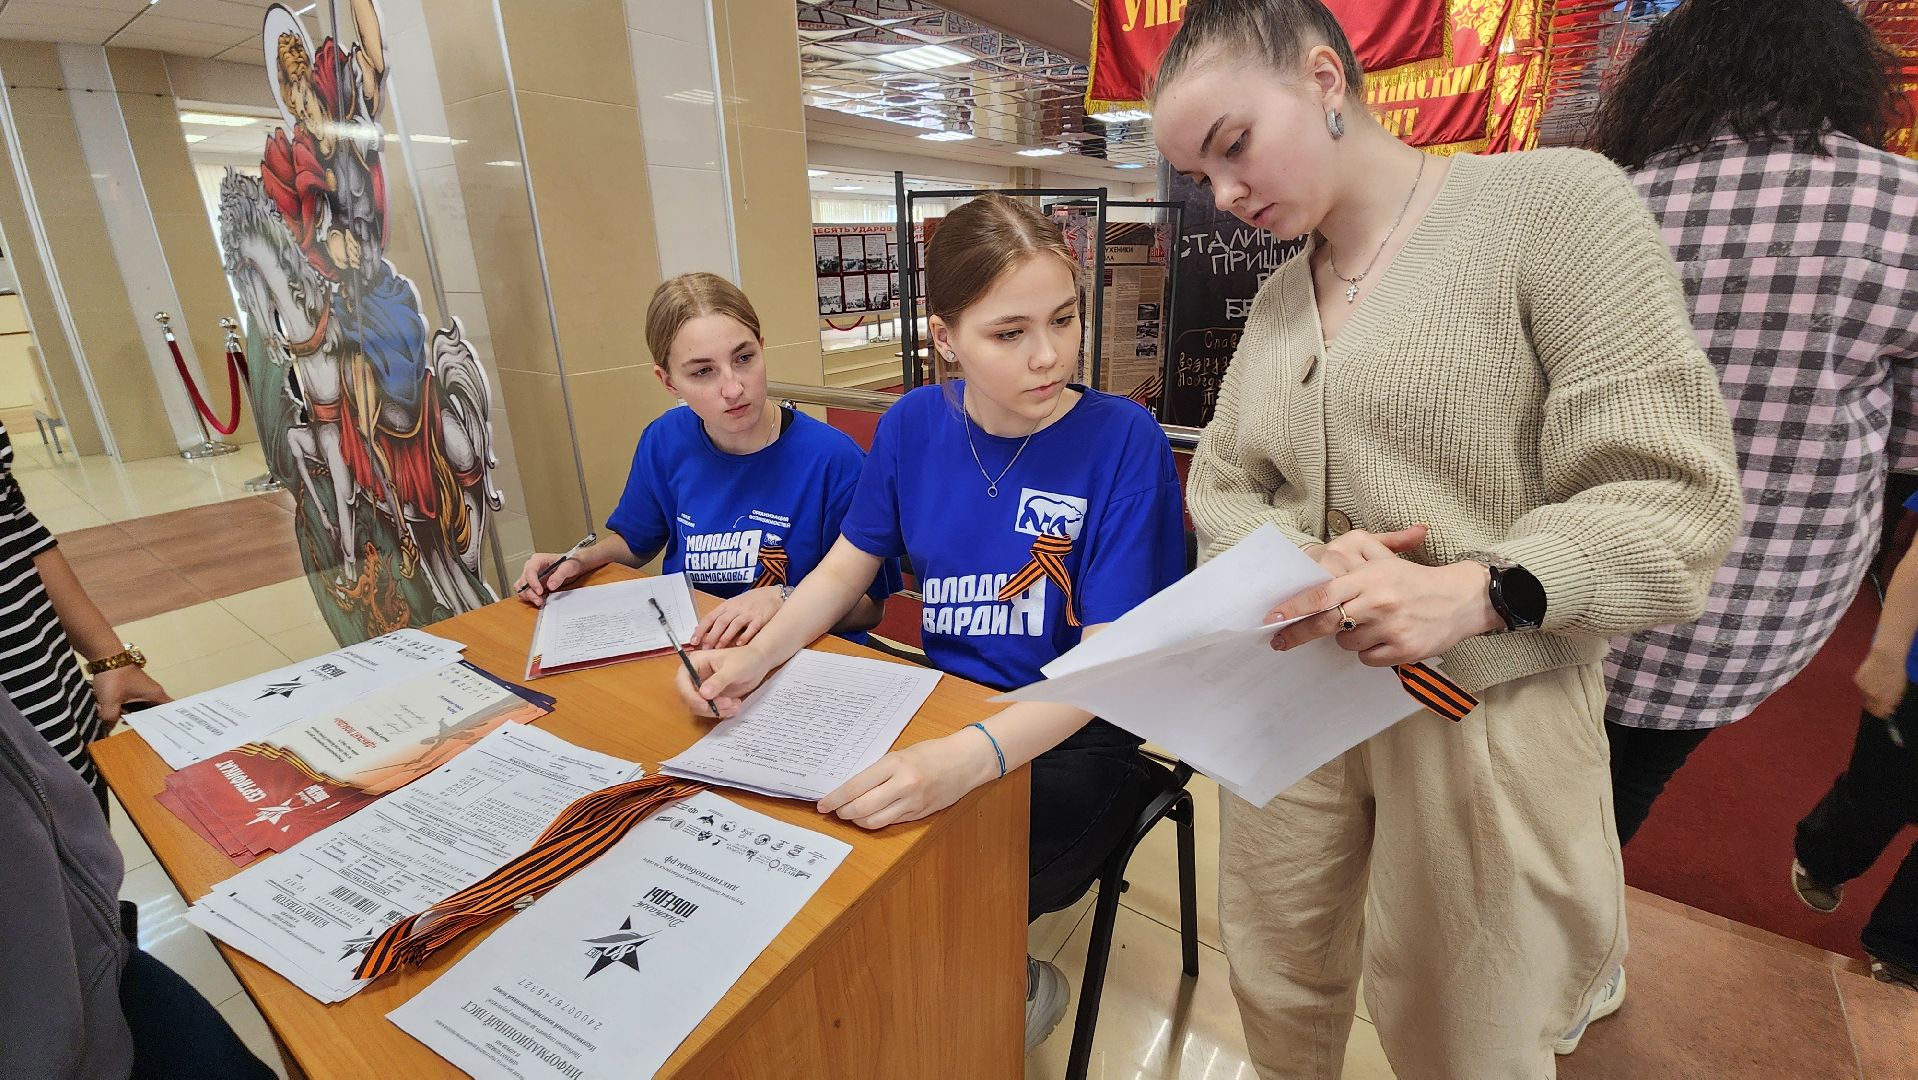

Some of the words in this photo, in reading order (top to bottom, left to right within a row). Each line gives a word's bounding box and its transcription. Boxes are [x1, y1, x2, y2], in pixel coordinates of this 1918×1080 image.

[852, 226, 893, 234] УДАРОВ
[1211, 245, 1300, 275] ПРИШЛ
[686, 530, 762, 554] МОЛОДАЯ
[685, 546, 760, 570] ГВАРДИЯ
[922, 603, 1045, 636] ВАРДИЯ
[214, 758, 267, 803] СЕРТИФИКАТ
[661, 853, 739, 892] диктантпобеды.рф
[271, 892, 305, 914] ОТВЕТОВ
[632, 900, 684, 928] Диктант
[642, 885, 698, 918] ПОБЕДЫ
[300, 909, 329, 929] БЛАНК
[583, 946, 600, 959] ЛЕТ
[459, 1000, 489, 1020] ЛИСТ
[481, 1013, 584, 1080] ИНФОРМАЦИОННЫЙ
